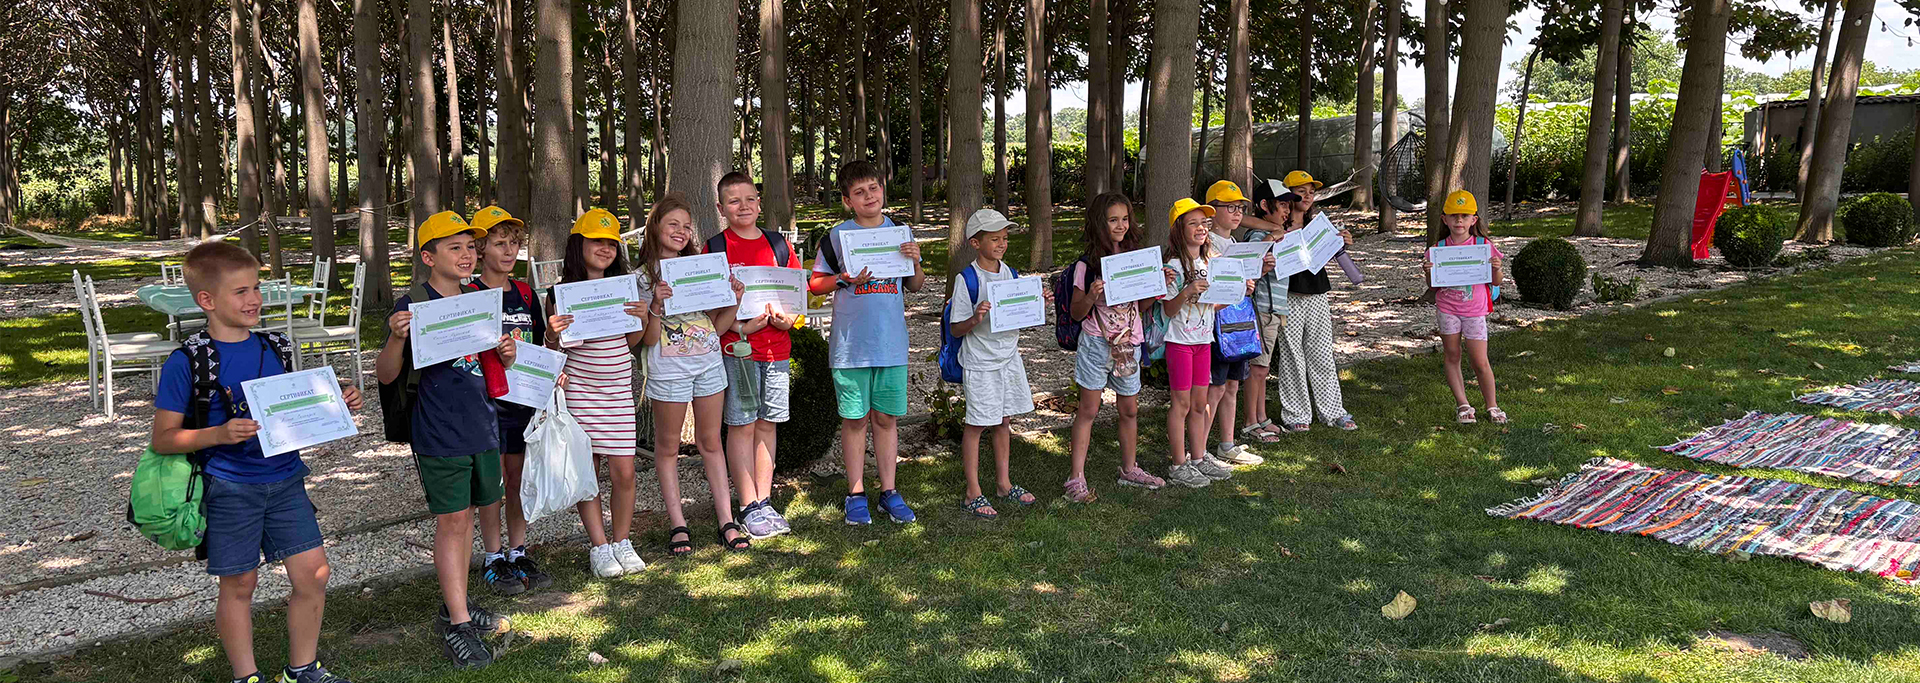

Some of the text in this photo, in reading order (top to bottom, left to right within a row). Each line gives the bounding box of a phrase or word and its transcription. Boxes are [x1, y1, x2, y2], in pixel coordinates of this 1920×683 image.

[580, 293, 614, 302] СЕРТИФИКАТ
[439, 308, 476, 321] СЕРТИФИКАТ
[279, 389, 315, 401] СЕРТИФИКАТ
